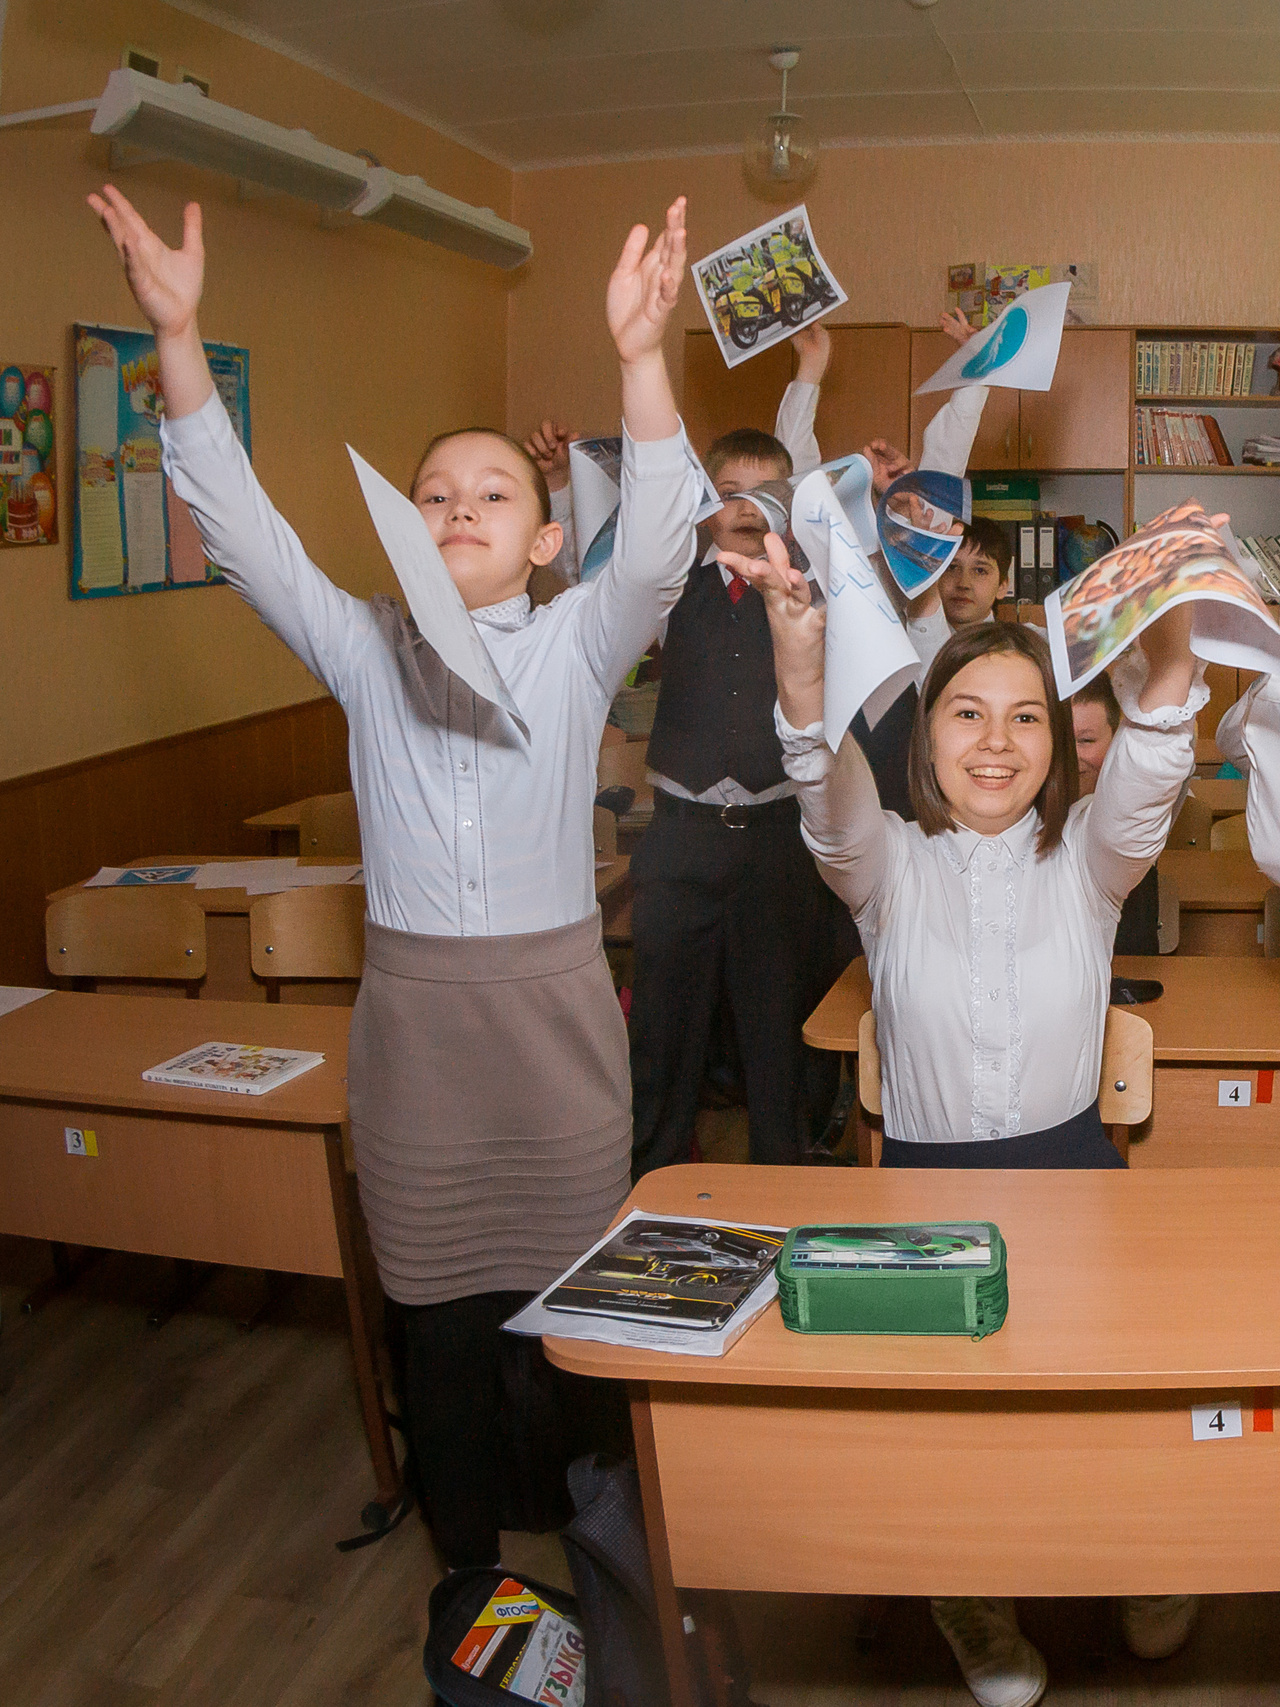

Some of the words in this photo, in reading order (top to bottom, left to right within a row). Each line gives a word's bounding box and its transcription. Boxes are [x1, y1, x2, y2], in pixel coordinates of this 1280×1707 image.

[1228, 1086, 1240, 1102] 4
[72, 1131, 82, 1149] 3
[1208, 1409, 1226, 1432] 4
[496, 1604, 530, 1618] ФГОС
